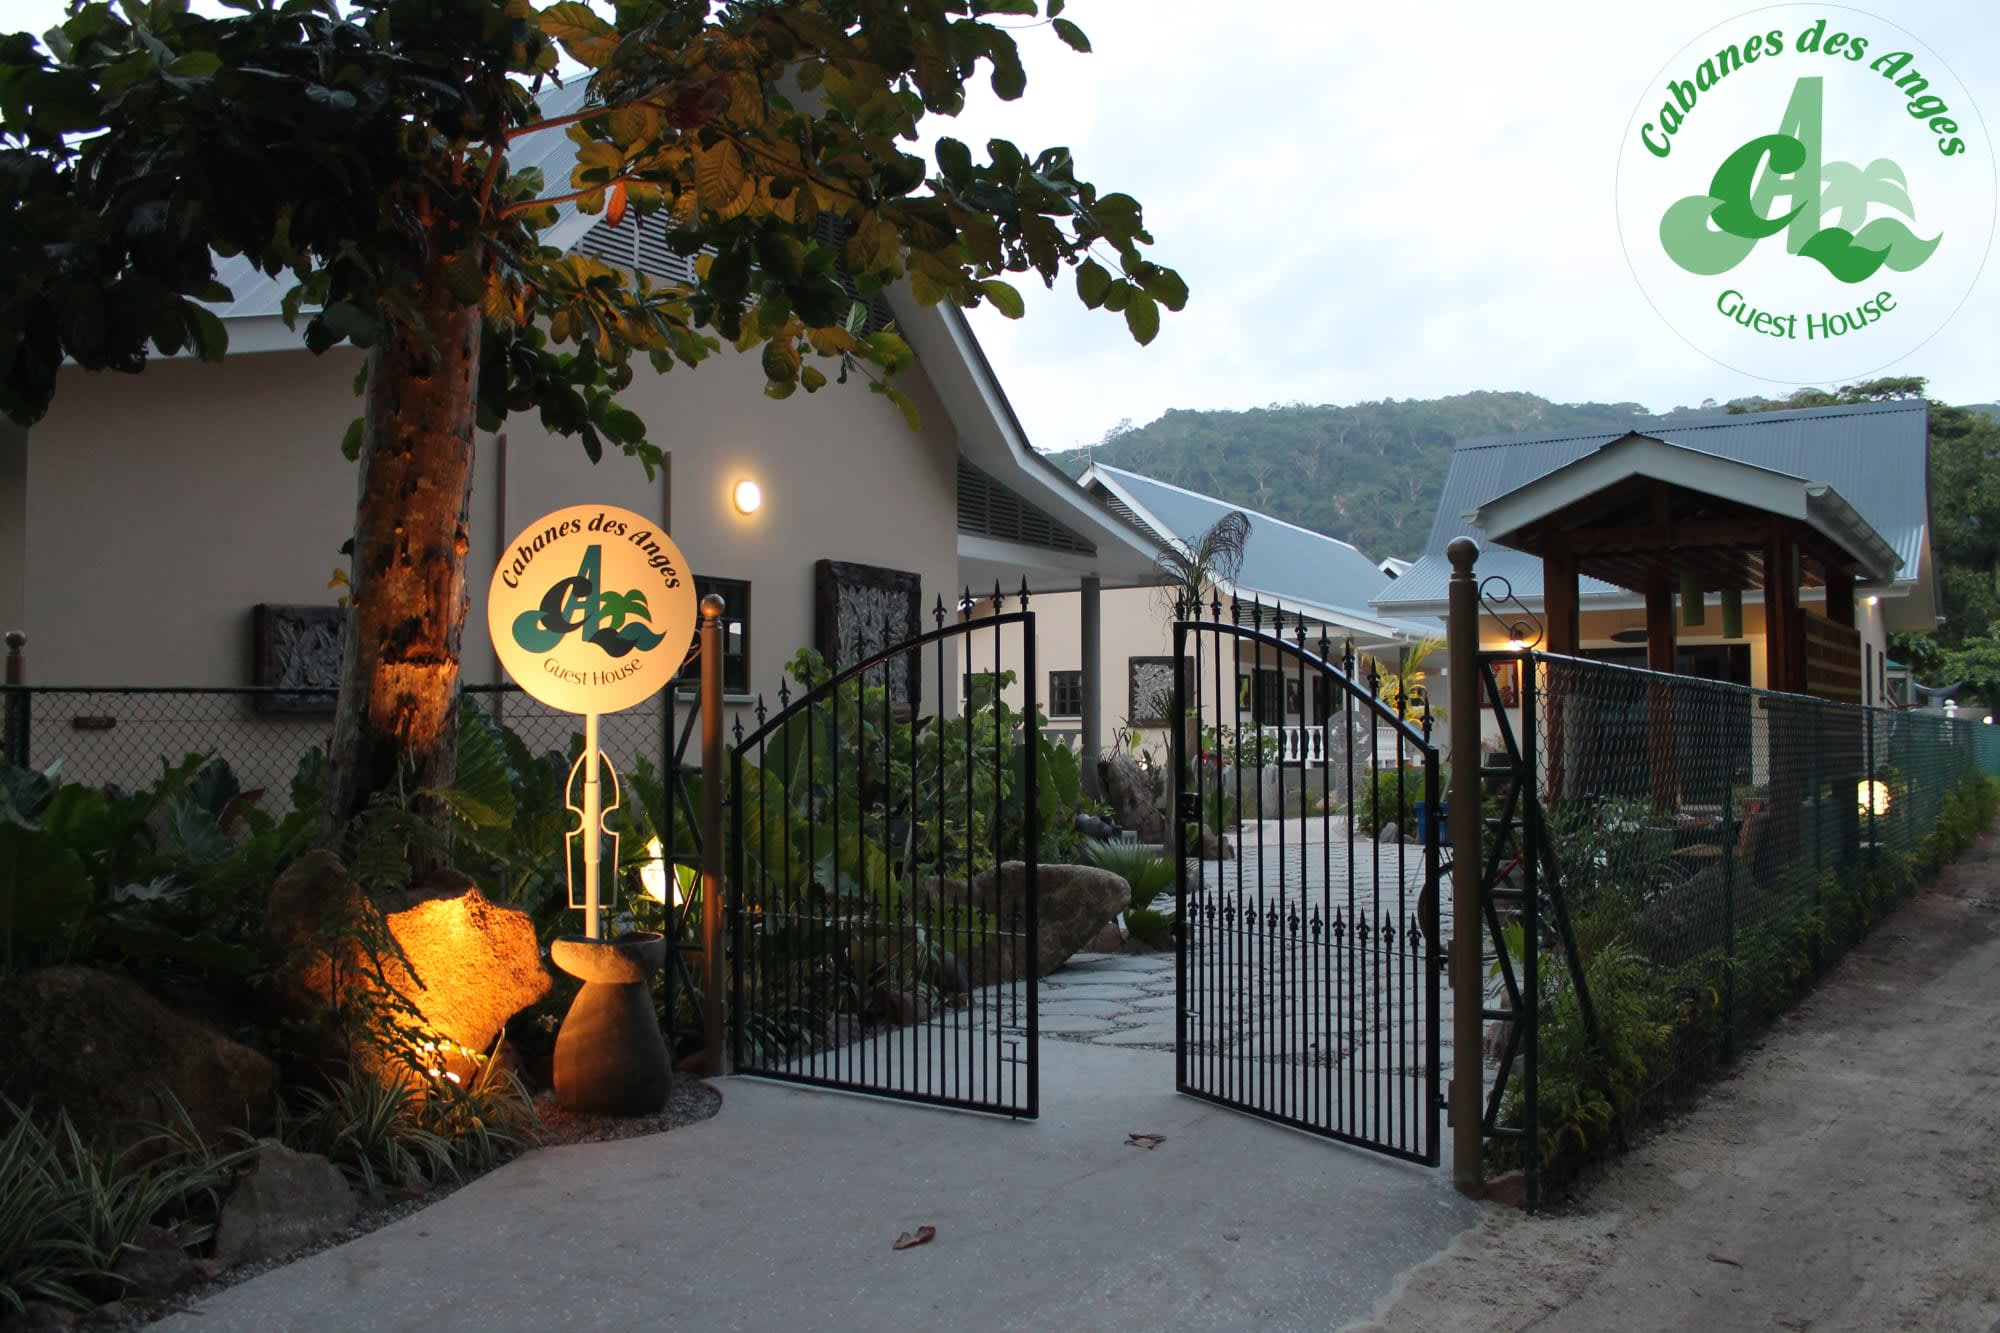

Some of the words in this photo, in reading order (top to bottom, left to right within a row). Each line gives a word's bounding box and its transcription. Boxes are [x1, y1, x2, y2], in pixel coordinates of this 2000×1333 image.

[502, 518, 581, 589] Cabanes
[587, 513, 628, 537] des
[628, 531, 680, 589] Anges
[544, 657, 588, 685] Guest
[593, 658, 643, 685] House
